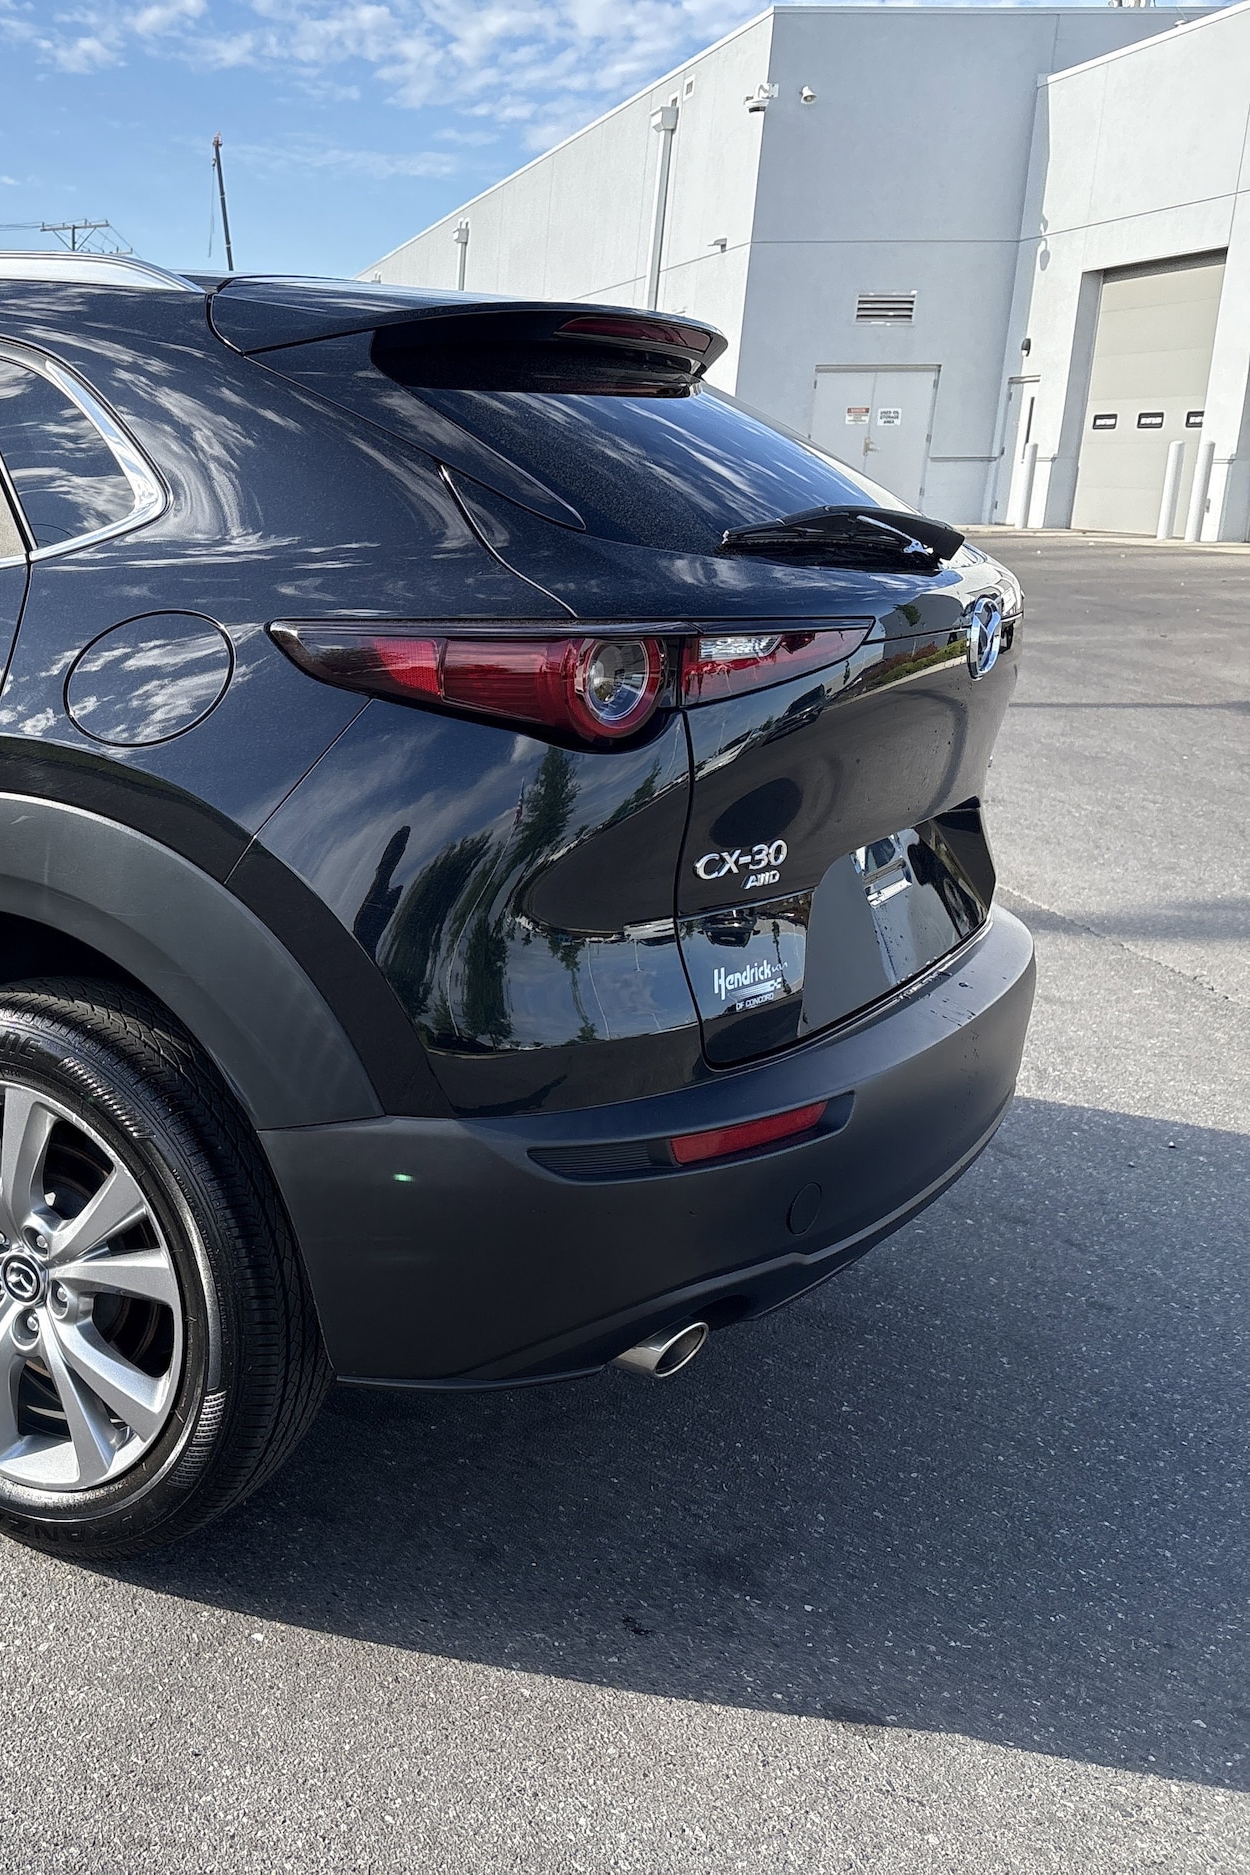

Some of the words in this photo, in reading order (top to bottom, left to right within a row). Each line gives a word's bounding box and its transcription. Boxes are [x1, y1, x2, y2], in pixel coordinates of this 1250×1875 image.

[693, 839, 788, 880] CX-30
[741, 870, 781, 890] AWD
[713, 959, 771, 1000] Hendrick
[736, 1001, 745, 1012] OF
